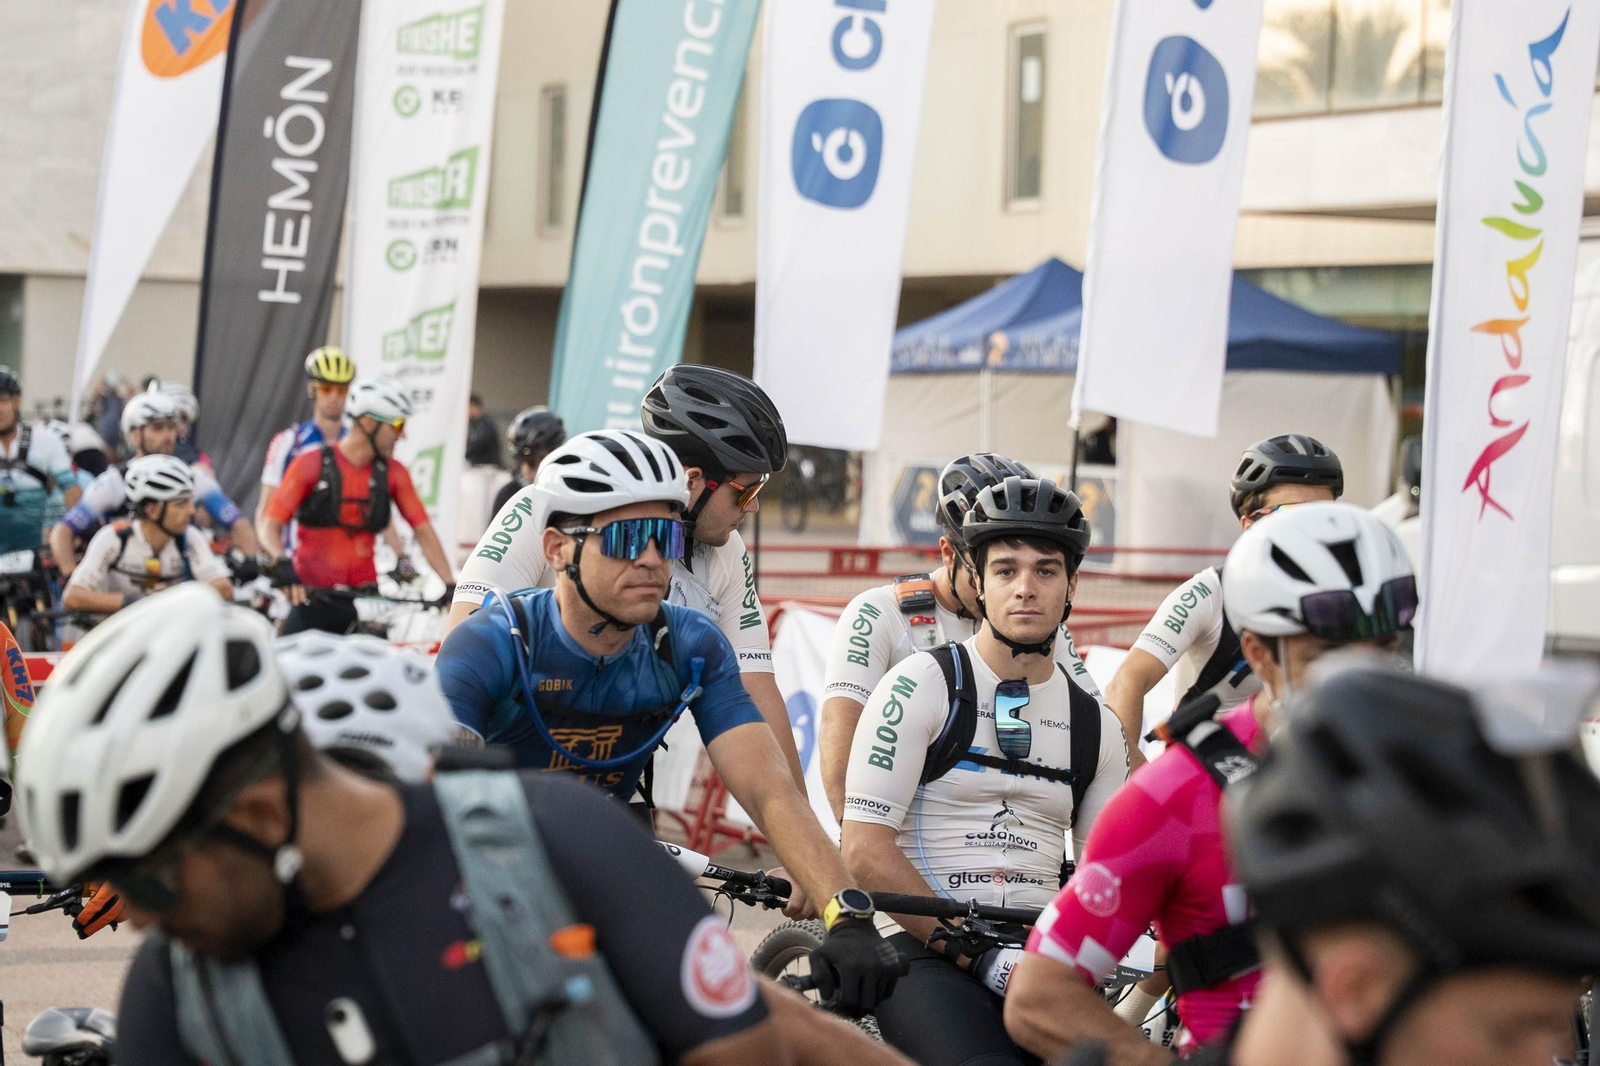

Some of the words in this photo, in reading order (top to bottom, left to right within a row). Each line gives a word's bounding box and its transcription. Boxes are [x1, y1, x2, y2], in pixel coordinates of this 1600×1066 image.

[1462, 6, 1571, 522] Andalucía
[847, 602, 882, 668] BLOOM
[1163, 581, 1212, 635] BLOOM
[538, 679, 573, 692] GOBIK
[868, 674, 919, 772] BLOOM
[977, 710, 996, 720] ERAS
[995, 961, 1013, 990] UAE
